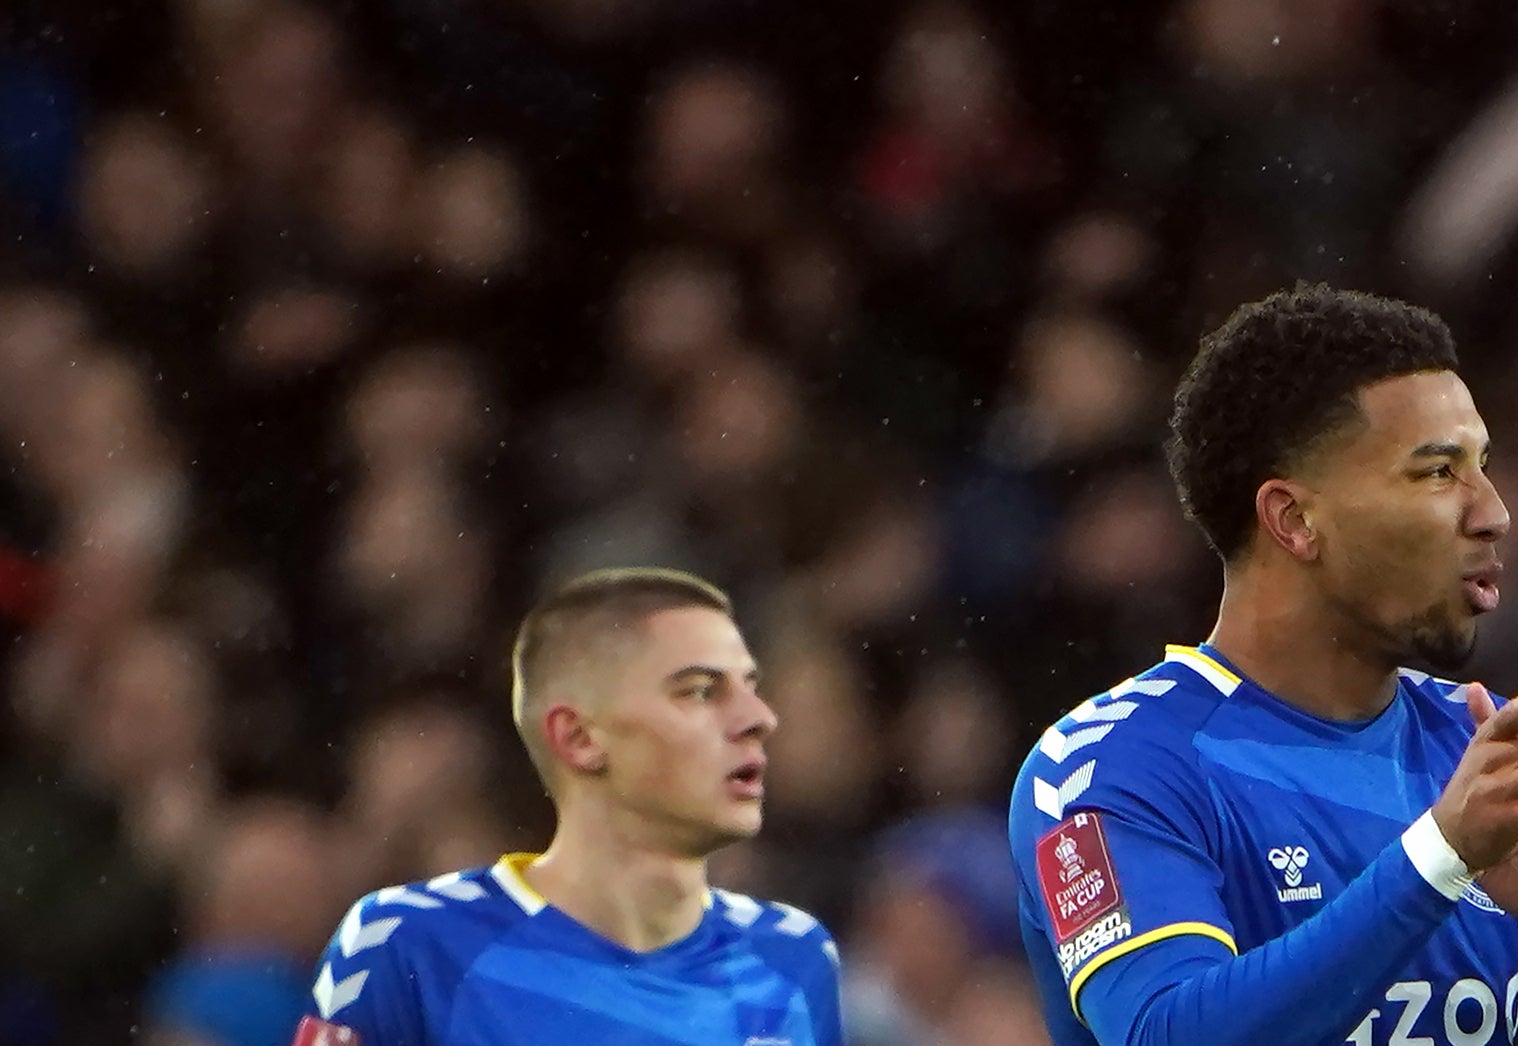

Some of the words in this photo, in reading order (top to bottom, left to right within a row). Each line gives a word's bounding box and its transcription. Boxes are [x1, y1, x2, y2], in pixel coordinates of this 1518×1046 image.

[1056, 869, 1102, 905] Emirates
[1059, 901, 1079, 919] FA
[1077, 879, 1106, 905] CUP
[1278, 882, 1322, 903] ummel
[1075, 912, 1121, 951] room
[1075, 923, 1131, 965] racism
